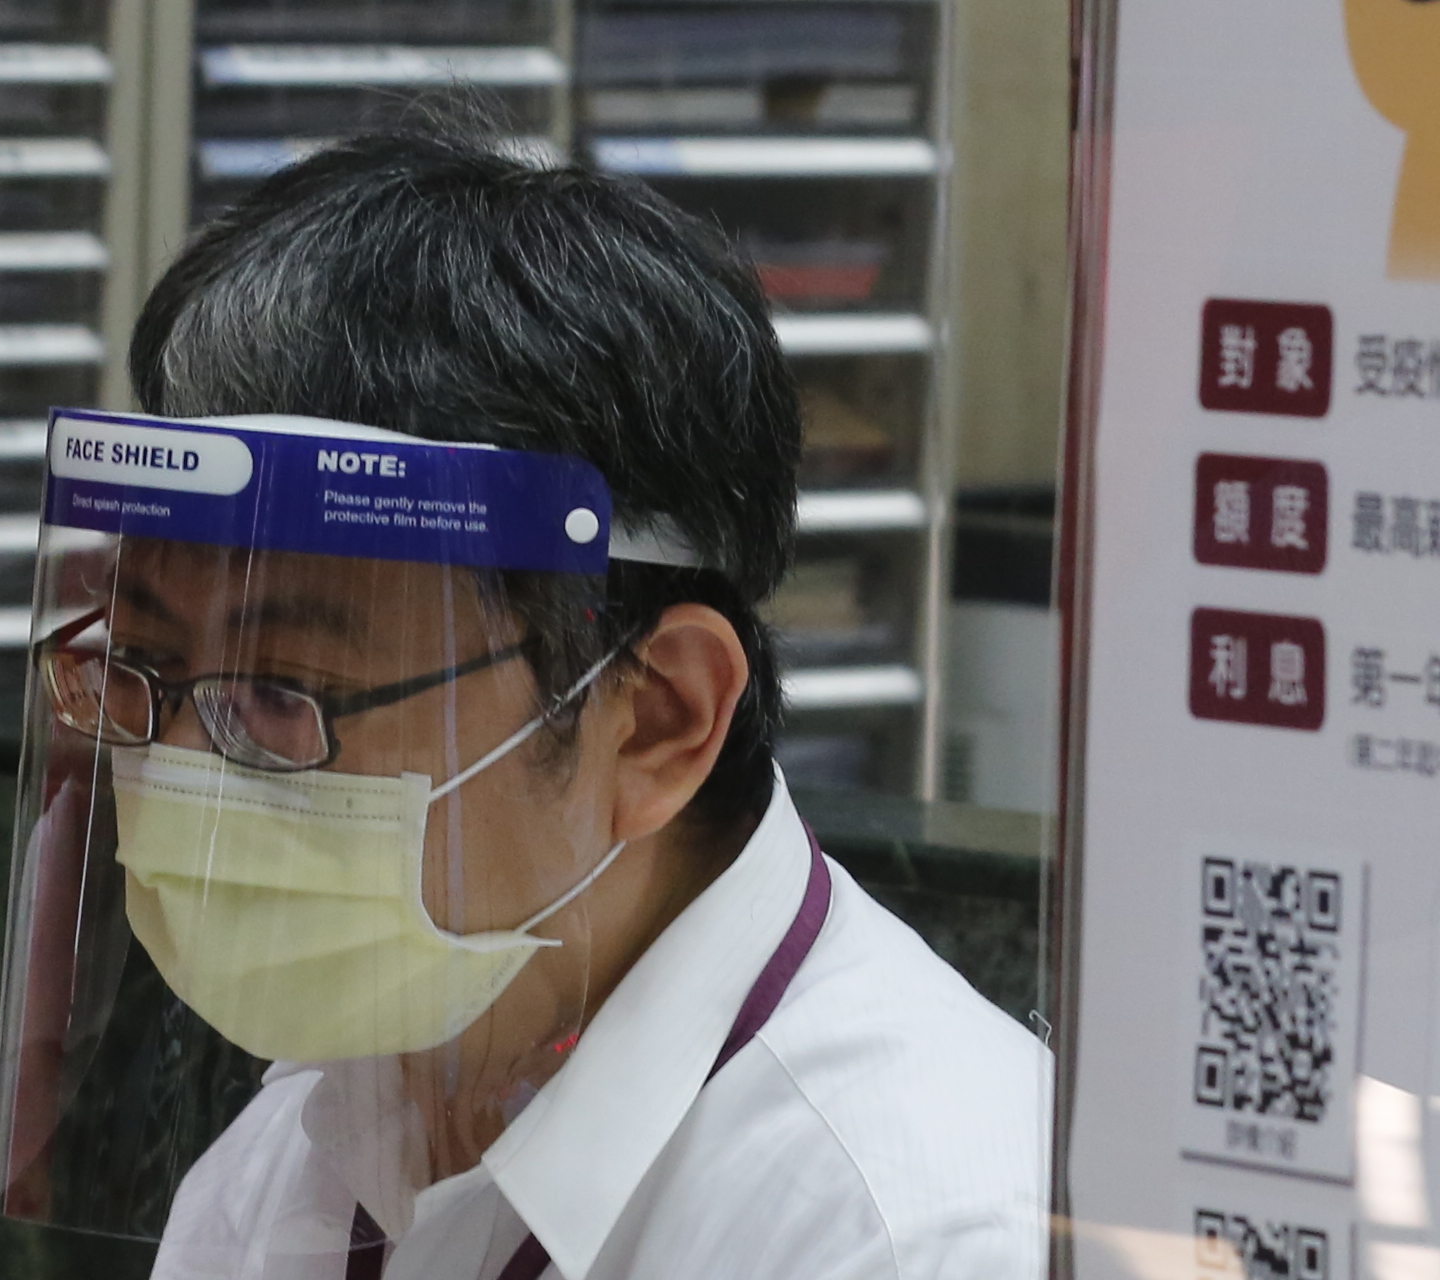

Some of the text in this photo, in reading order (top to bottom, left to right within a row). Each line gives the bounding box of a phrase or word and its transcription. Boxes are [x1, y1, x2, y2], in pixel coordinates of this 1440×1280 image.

[1218, 324, 1313, 391] 對象
[66, 437, 200, 471] FACE SHIELD
[317, 449, 406, 478] NOTE:
[73, 493, 170, 517] Direct splash protection
[324, 490, 487, 515] Please gently remove the
[1213, 480, 1310, 550] 額度
[324, 510, 390, 525] protective
[393, 513, 417, 528] film
[420, 516, 461, 531] before
[1208, 633, 1308, 706] 利息
